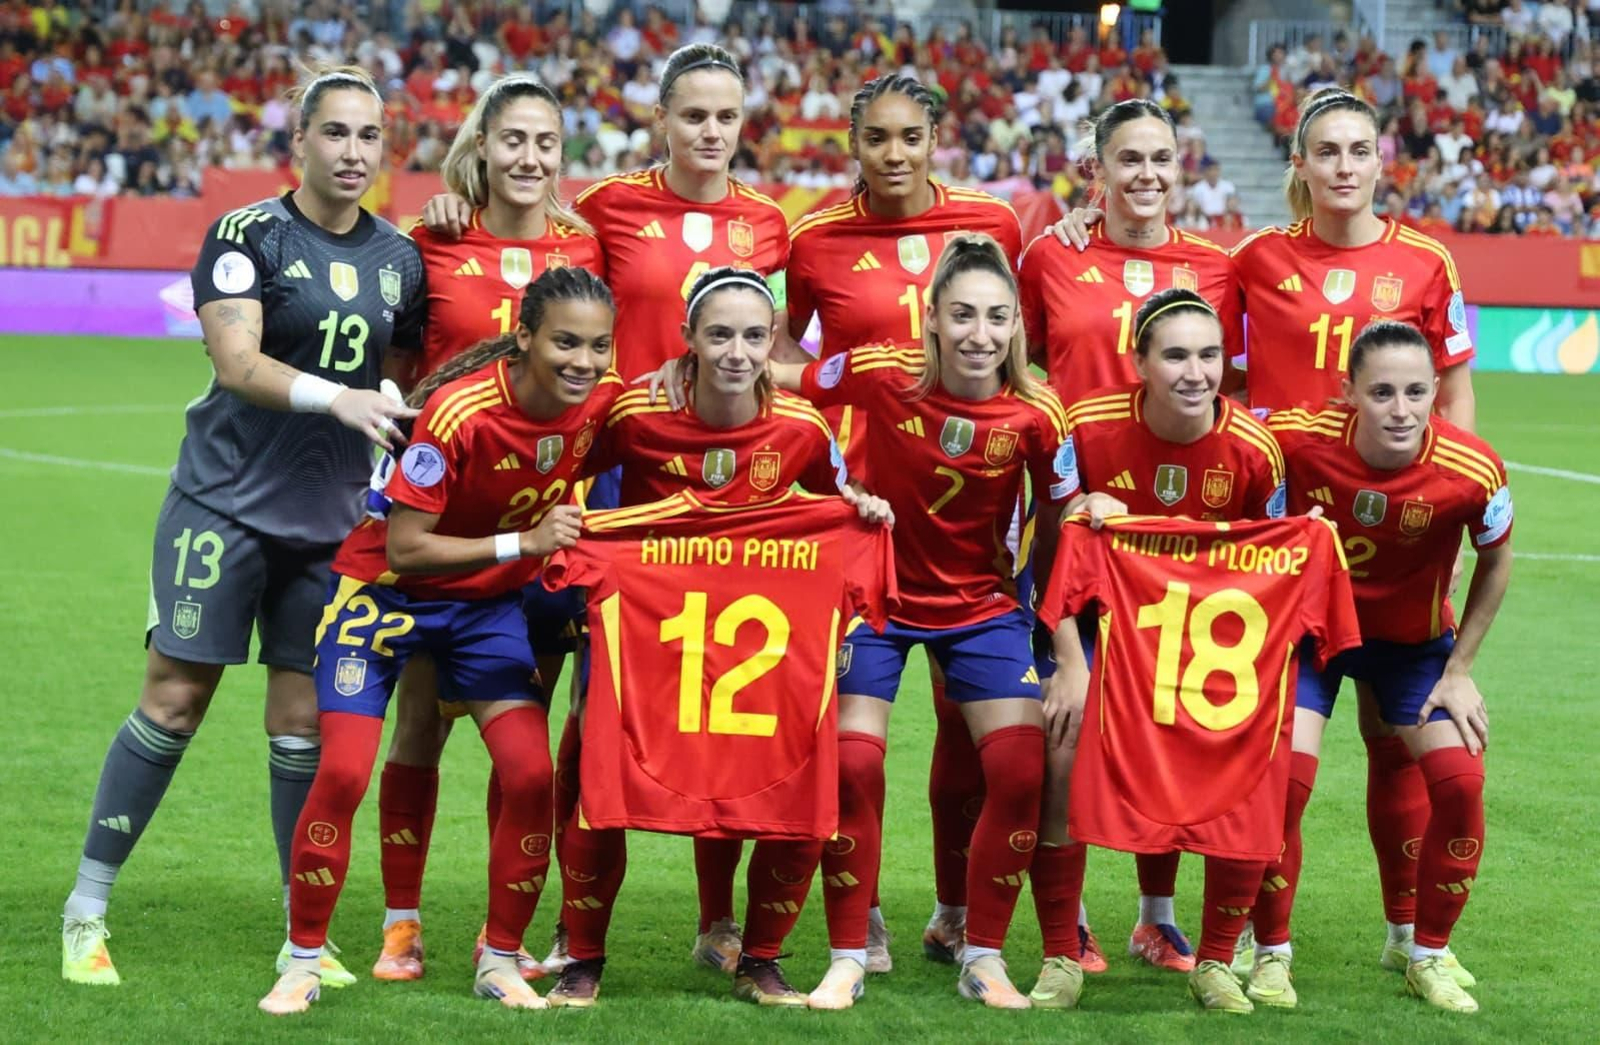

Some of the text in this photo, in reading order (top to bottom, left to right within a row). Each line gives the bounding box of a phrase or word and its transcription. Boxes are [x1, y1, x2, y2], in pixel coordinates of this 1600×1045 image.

[318, 310, 370, 372] 13
[1309, 313, 1354, 372] 11
[497, 478, 568, 530] 22
[928, 466, 965, 514] 7
[173, 528, 225, 589] 13
[641, 529, 819, 570] ÁNIMO PATRI
[1344, 535, 1377, 577] 2
[336, 594, 416, 657] 22
[1136, 580, 1269, 731] 18
[659, 591, 790, 737] 12
